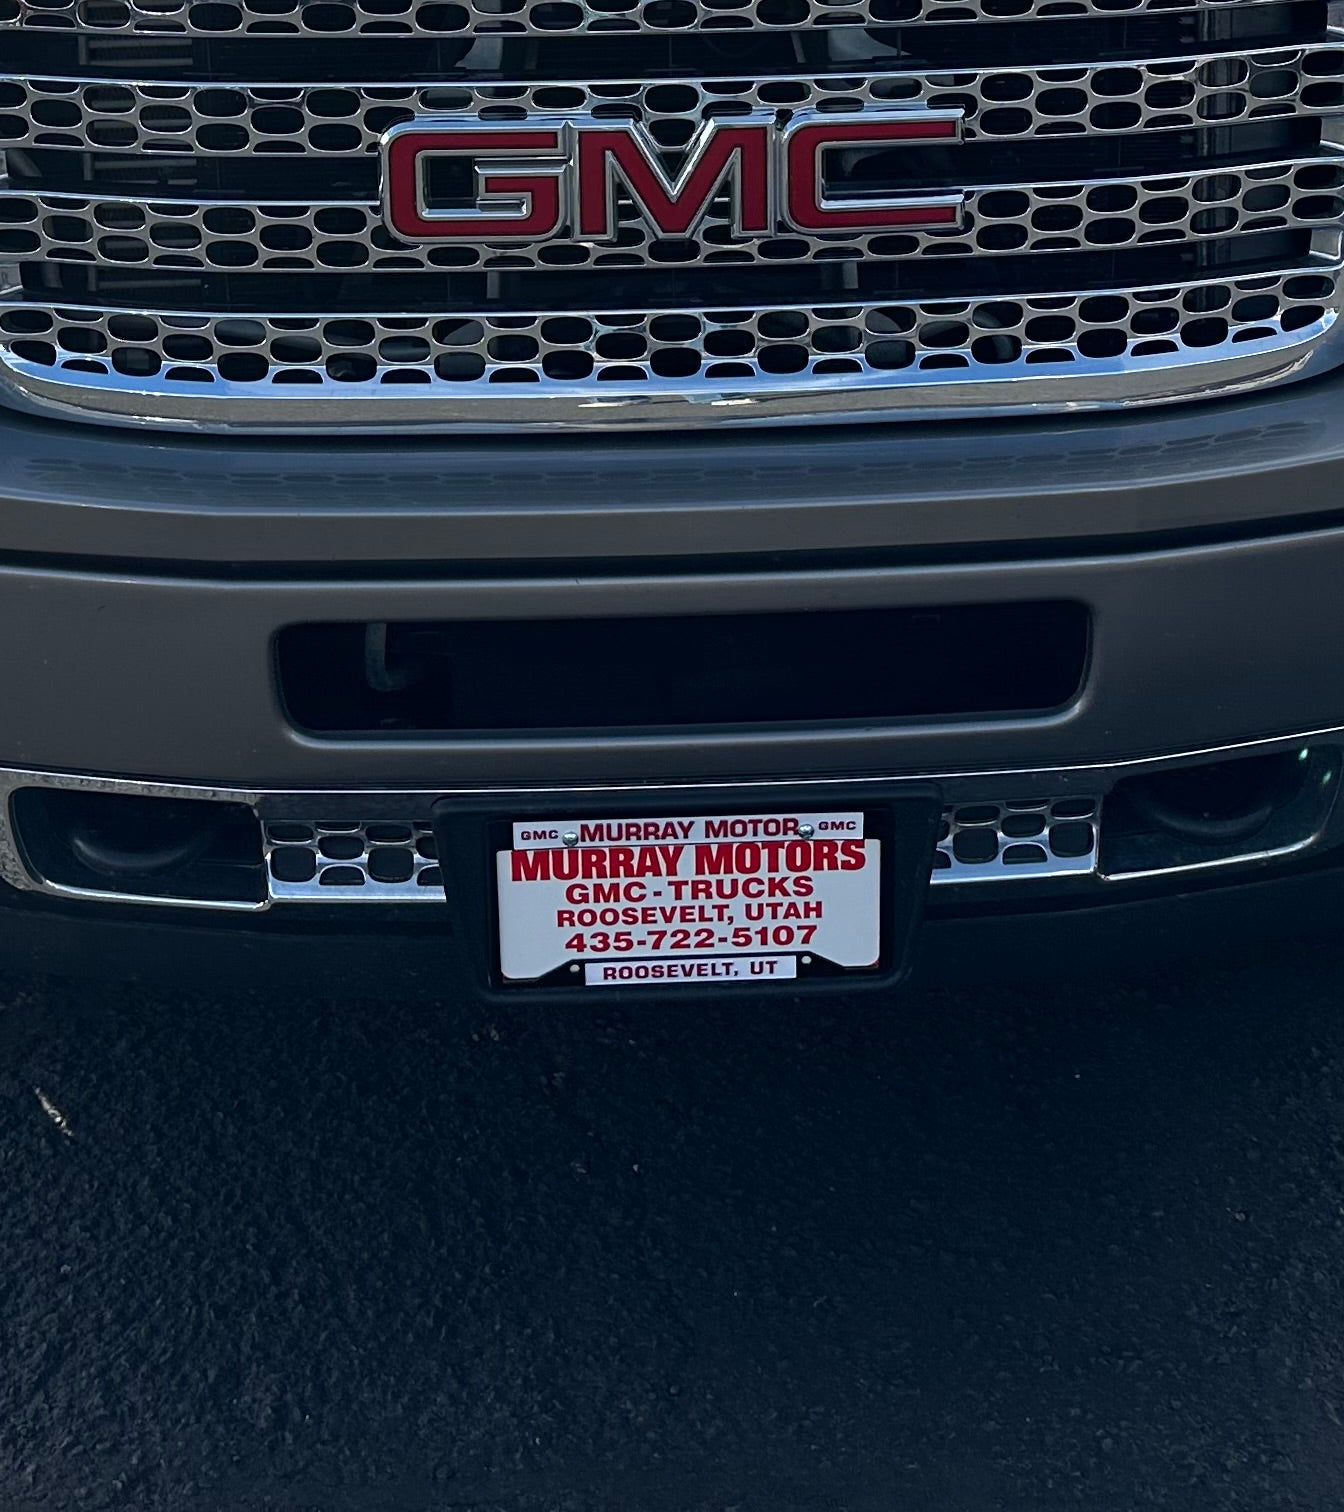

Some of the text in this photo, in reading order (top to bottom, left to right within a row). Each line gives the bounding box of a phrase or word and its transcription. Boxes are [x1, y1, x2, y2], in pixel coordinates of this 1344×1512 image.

[380, 107, 965, 243] GMC
[521, 829, 559, 841] GMC
[580, 818, 799, 843] MURRAY MOTOR
[818, 819, 856, 831] GMC
[511, 839, 867, 882] MURRAY MOTORS
[565, 881, 647, 905] GMC
[668, 875, 814, 901] TRUCKS
[557, 901, 823, 927] ROOSEVELT, UTAH
[565, 925, 818, 953] 435-722-5107
[603, 961, 778, 980] ROOSEVELT, UT
